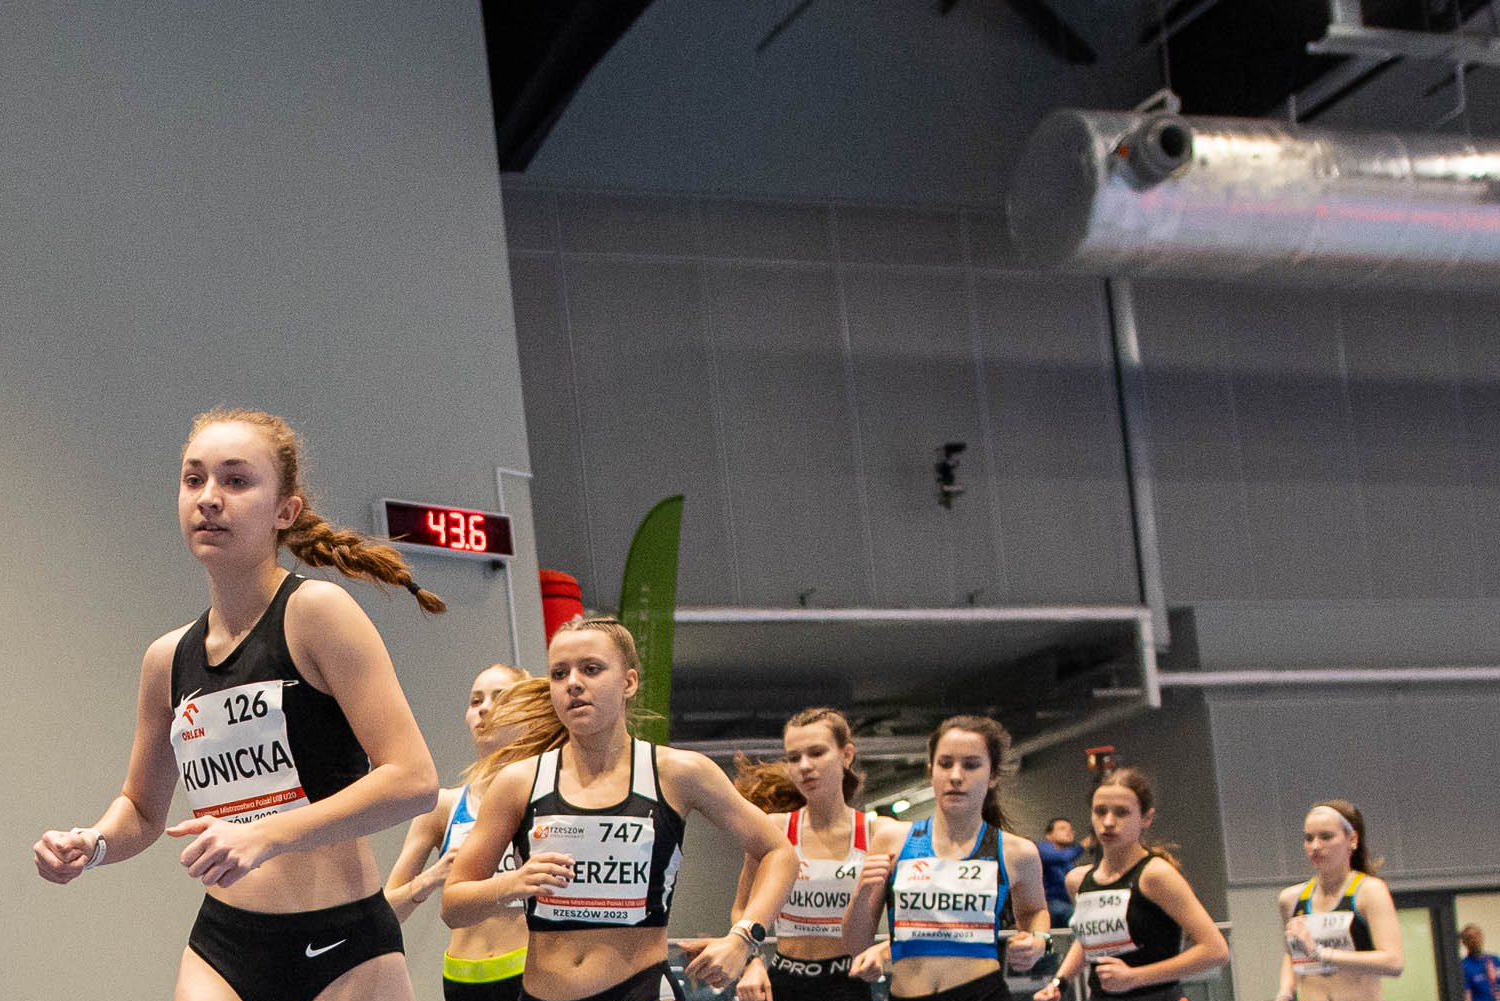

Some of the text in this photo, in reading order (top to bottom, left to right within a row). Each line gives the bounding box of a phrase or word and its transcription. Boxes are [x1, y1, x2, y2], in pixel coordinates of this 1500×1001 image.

[426, 510, 486, 551] 43.6
[223, 690, 268, 725] 126
[181, 727, 205, 741] ORLEN
[182, 740, 293, 792] KUNICKA
[599, 823, 643, 843] 747
[835, 865, 856, 879] 64
[958, 866, 981, 880] 22
[788, 890, 851, 908] UŁKOWS
[899, 892, 991, 912] SZUBERT
[553, 908, 628, 919] RZESZÓW 2023
[778, 959, 823, 977] PRO
[829, 957, 852, 975] NI
